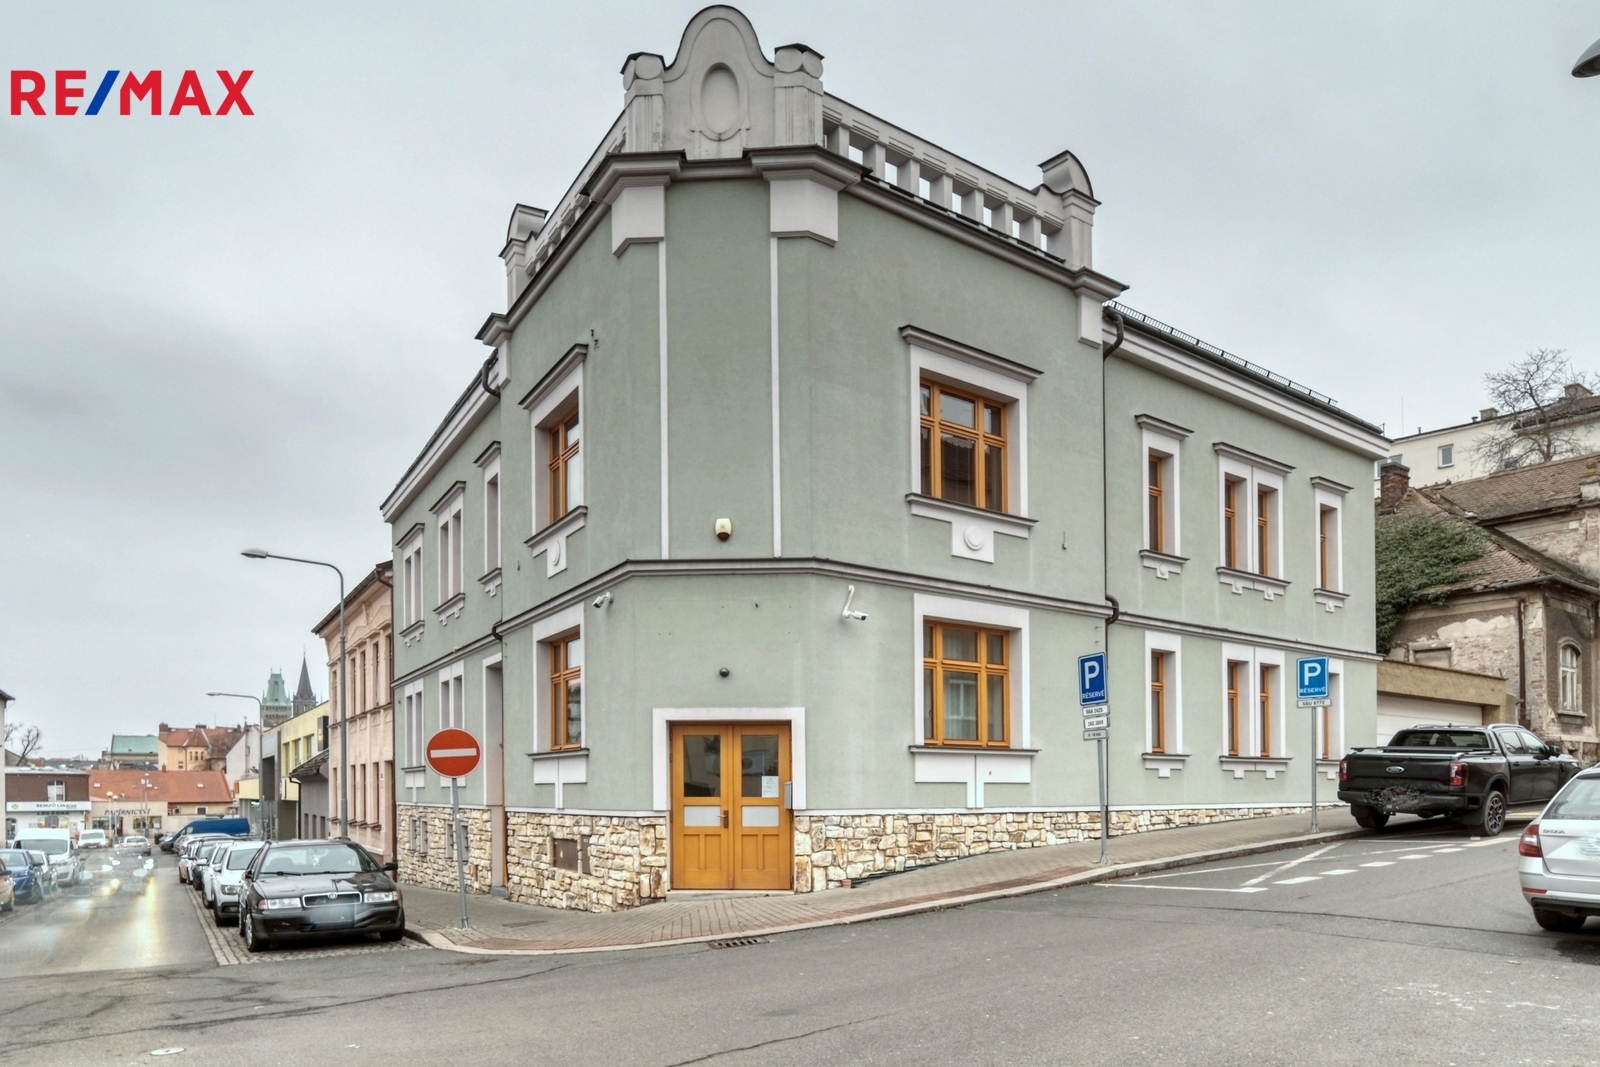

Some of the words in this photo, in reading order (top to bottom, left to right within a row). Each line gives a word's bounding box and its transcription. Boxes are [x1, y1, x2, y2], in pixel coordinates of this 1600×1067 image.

[1084, 661, 1100, 689] P
[1304, 663, 1321, 685] P
[104, 808, 151, 816] PAPÍRNICTVÍ
